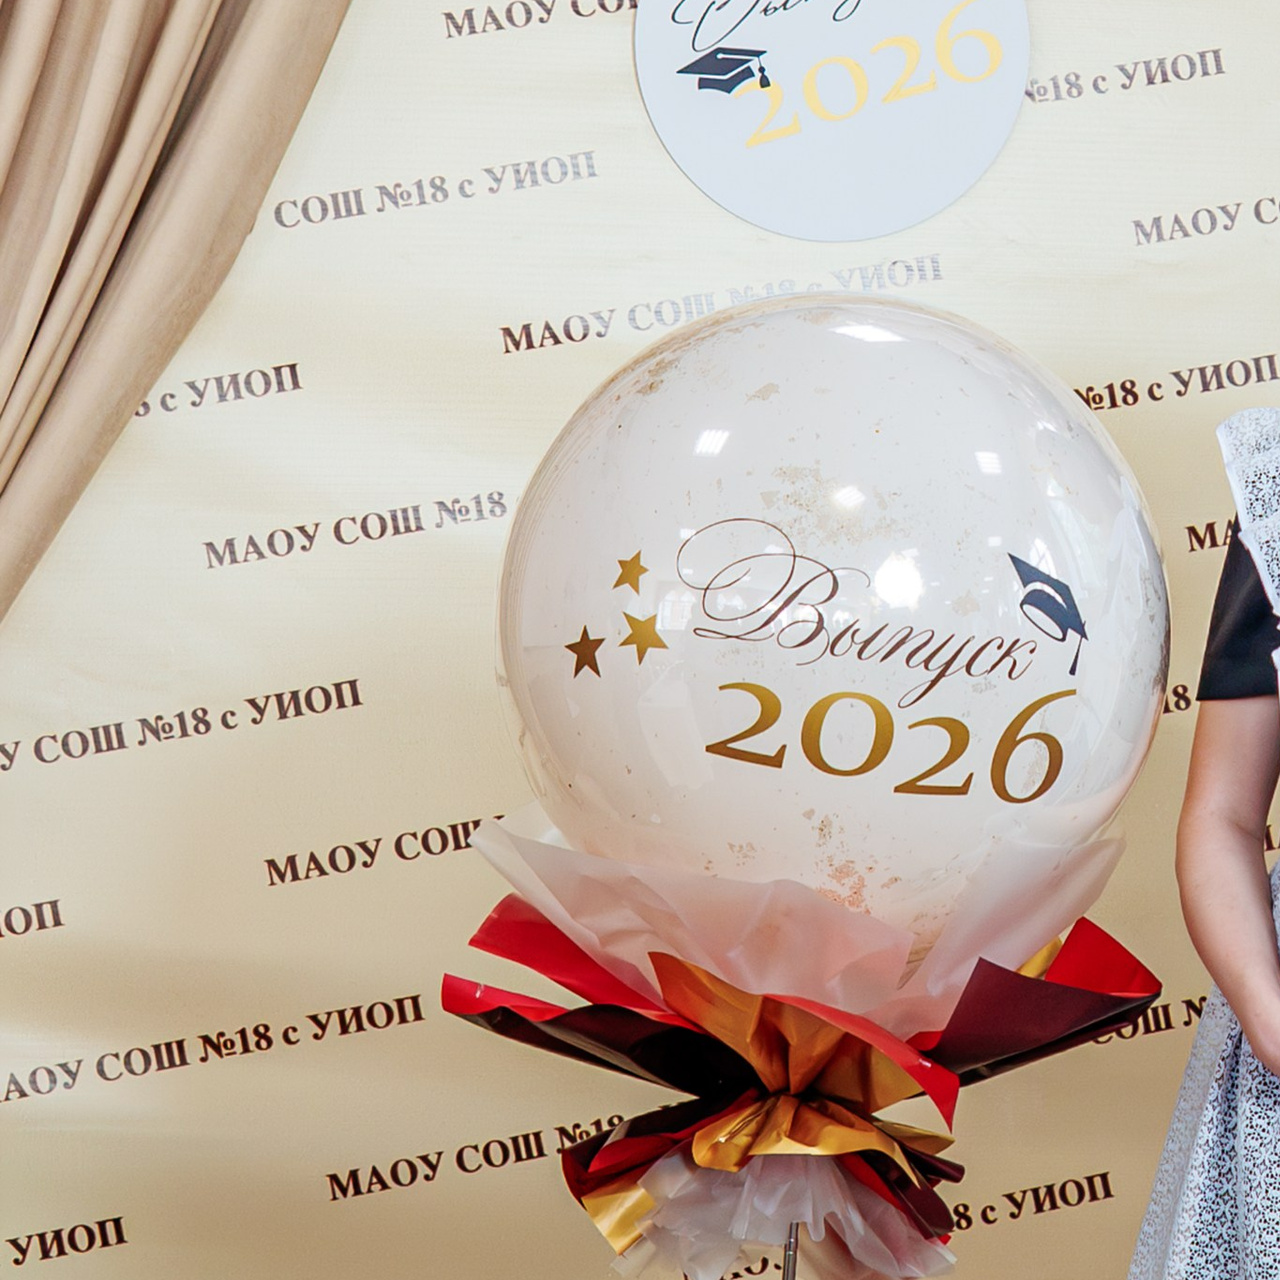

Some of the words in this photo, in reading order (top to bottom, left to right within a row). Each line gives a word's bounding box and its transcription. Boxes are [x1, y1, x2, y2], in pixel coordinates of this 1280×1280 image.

[1092, 75, 1107, 94] с
[1116, 48, 1226, 90] УИОП
[273, 188, 366, 229] СОШ
[375, 175, 449, 213] №18
[458, 179, 475, 199] с
[481, 150, 598, 195] УИОП
[1132, 202, 1242, 244] МАОУ
[500, 308, 615, 355] МАОУ
[159, 392, 177, 412] с
[184, 362, 302, 408] УИОП
[1147, 382, 1164, 402] с
[1170, 354, 1280, 398] УИОП
[203, 522, 321, 569] МАОУ
[333, 505, 425, 545] СОШ
[434, 491, 507, 529] №18
[676, 517, 1039, 709] Выпуск
[33, 722, 128, 764] СОШ
[137, 707, 212, 747] №18
[220, 710, 238, 730] с
[244, 678, 363, 725] УИОП
[705, 681, 1078, 805] 2026
[264, 837, 382, 887] МАОУ
[0, 1058, 84, 1103] АОУ
[96, 1038, 190, 1081] СОШ
[197, 1023, 274, 1063] №18
[282, 1026, 300, 1046] с
[305, 994, 425, 1041] УИОП
[326, 1151, 444, 1202] МАОУ
[455, 1130, 548, 1174] СОШ
[980, 1205, 998, 1225] с
[1002, 1171, 1114, 1220] УИОП
[5, 1216, 128, 1266] УИОП
